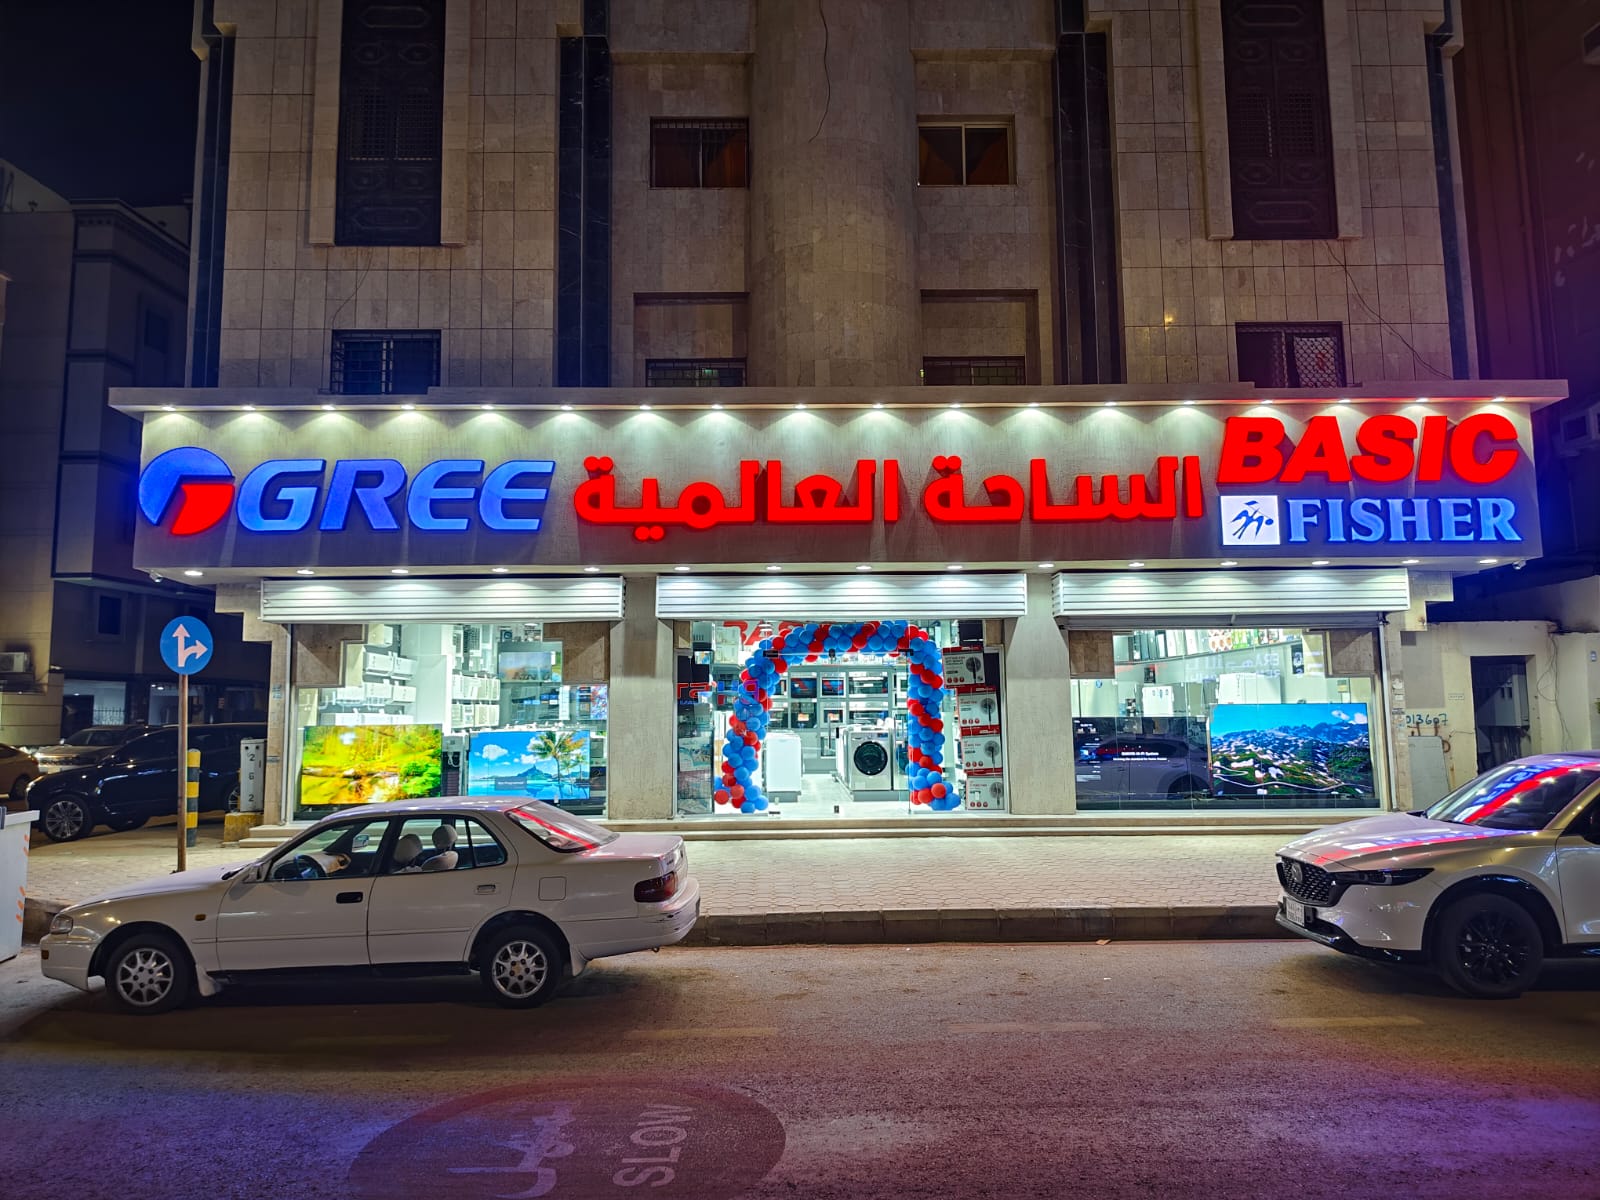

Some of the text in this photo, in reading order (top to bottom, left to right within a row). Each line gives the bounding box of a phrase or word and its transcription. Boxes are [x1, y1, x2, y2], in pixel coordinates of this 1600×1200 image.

[1218, 413, 1519, 484] BASIC
[237, 459, 556, 531] GREE
[573, 454, 1204, 542] الساحة العالمية
[1288, 496, 1522, 543] FISHER
[612, 1103, 696, 1187] SLOW
